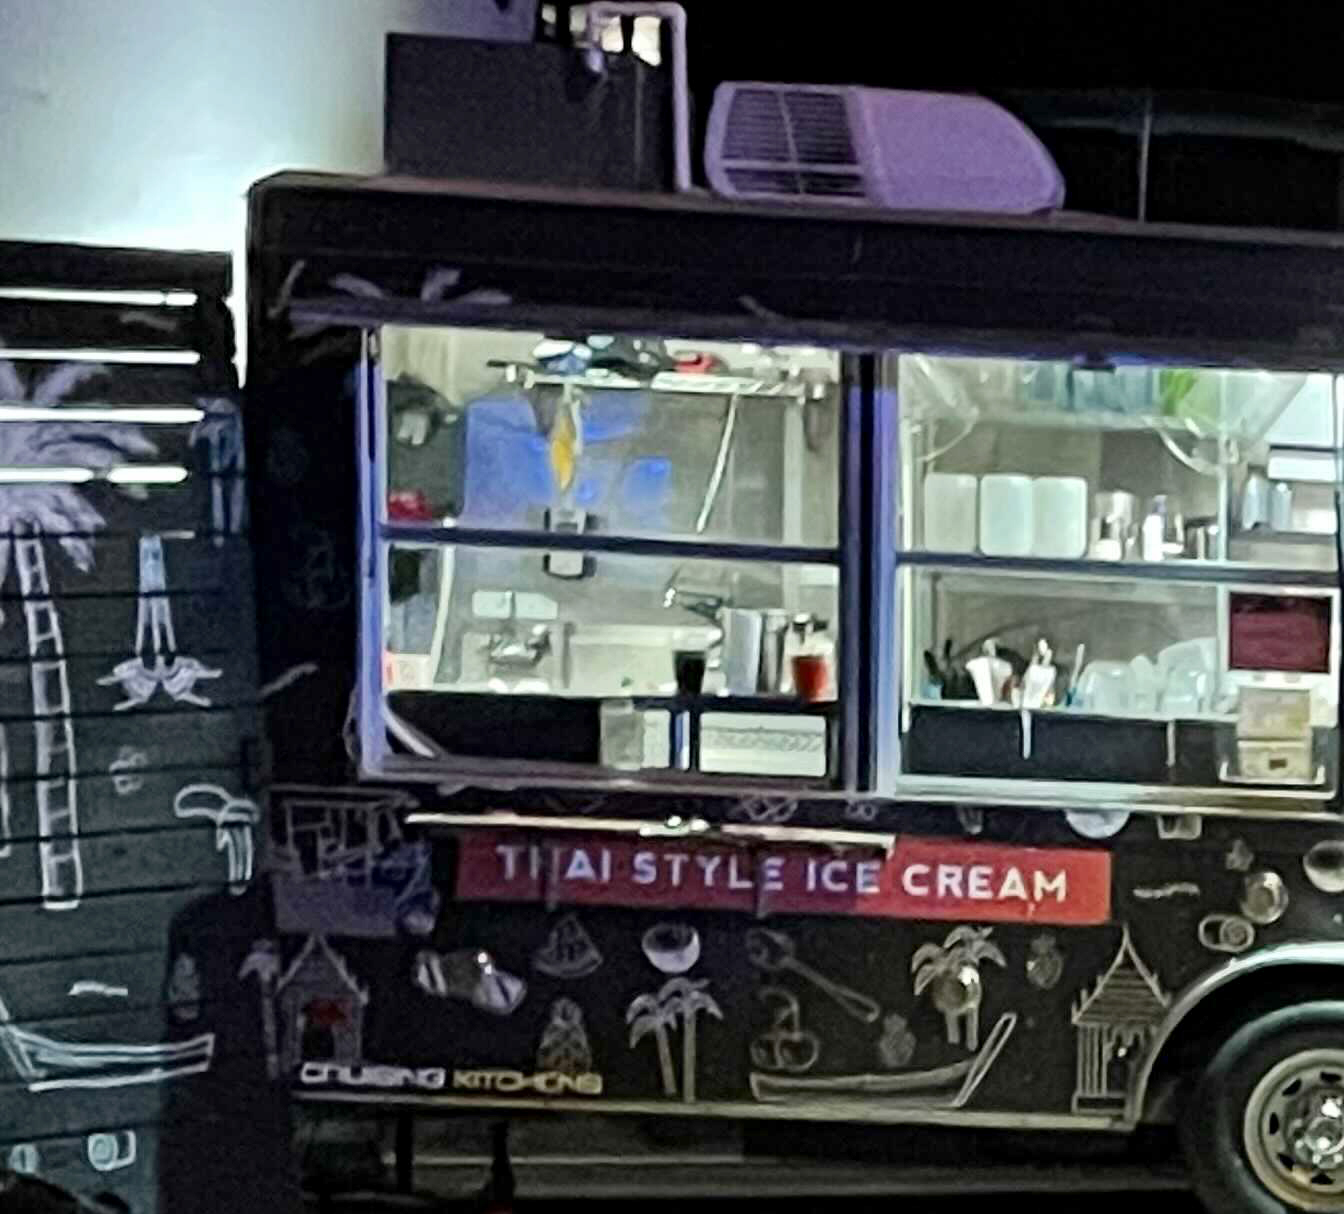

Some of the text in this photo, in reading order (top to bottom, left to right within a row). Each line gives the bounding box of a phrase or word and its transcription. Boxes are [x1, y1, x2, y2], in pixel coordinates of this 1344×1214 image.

[632, 849, 785, 891] STYLE
[806, 859, 881, 893] ICE
[901, 863, 1068, 902] CREAM
